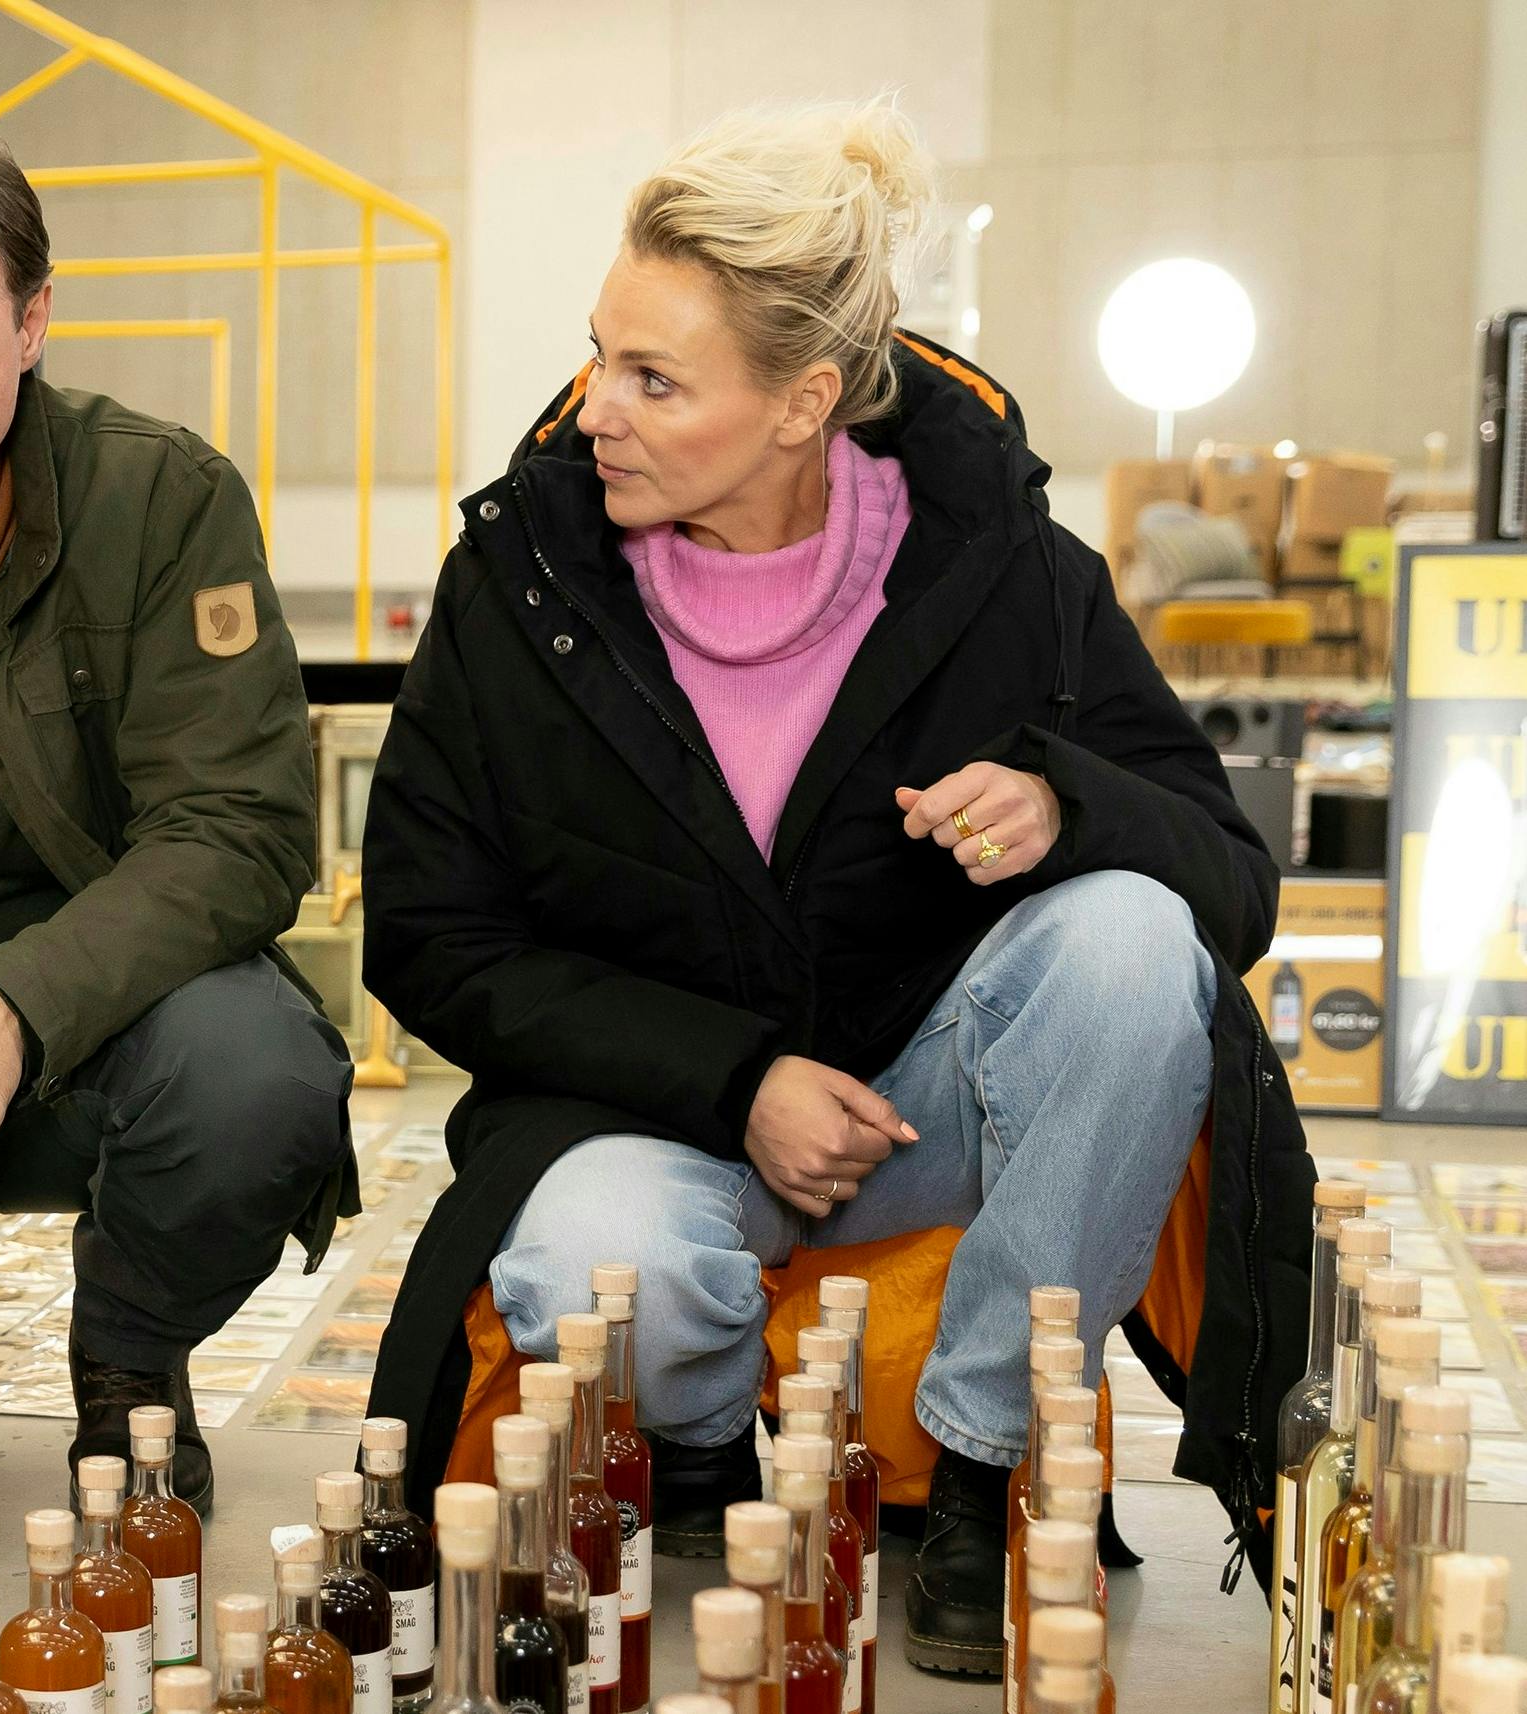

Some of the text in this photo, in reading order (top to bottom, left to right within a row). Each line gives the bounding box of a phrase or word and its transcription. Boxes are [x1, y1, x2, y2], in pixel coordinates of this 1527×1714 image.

[395, 1617, 416, 1629] SMAG
[588, 1625, 605, 1636] MAG
[353, 1683, 370, 1695] MAG
